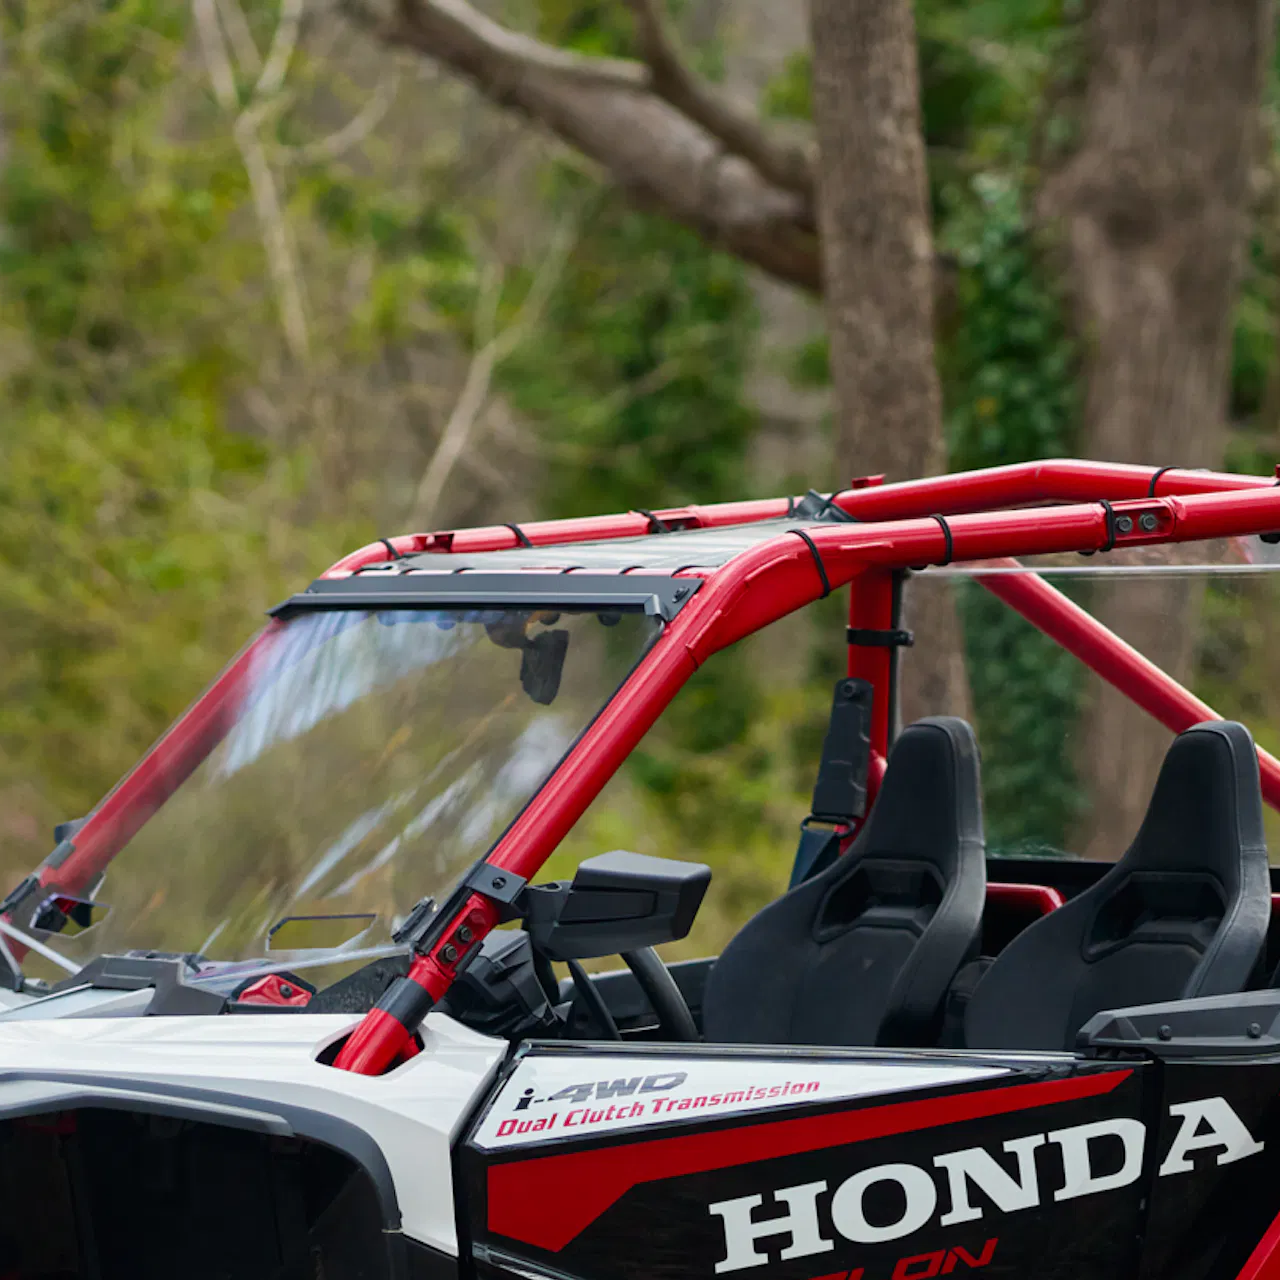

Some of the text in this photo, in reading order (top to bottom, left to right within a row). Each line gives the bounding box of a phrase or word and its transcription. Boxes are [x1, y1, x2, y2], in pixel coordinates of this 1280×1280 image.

[495, 1080, 821, 1138] Dual Clutch Transmission
[512, 1071, 688, 1112] i-4WD
[707, 1096, 1265, 1274] HONDA
